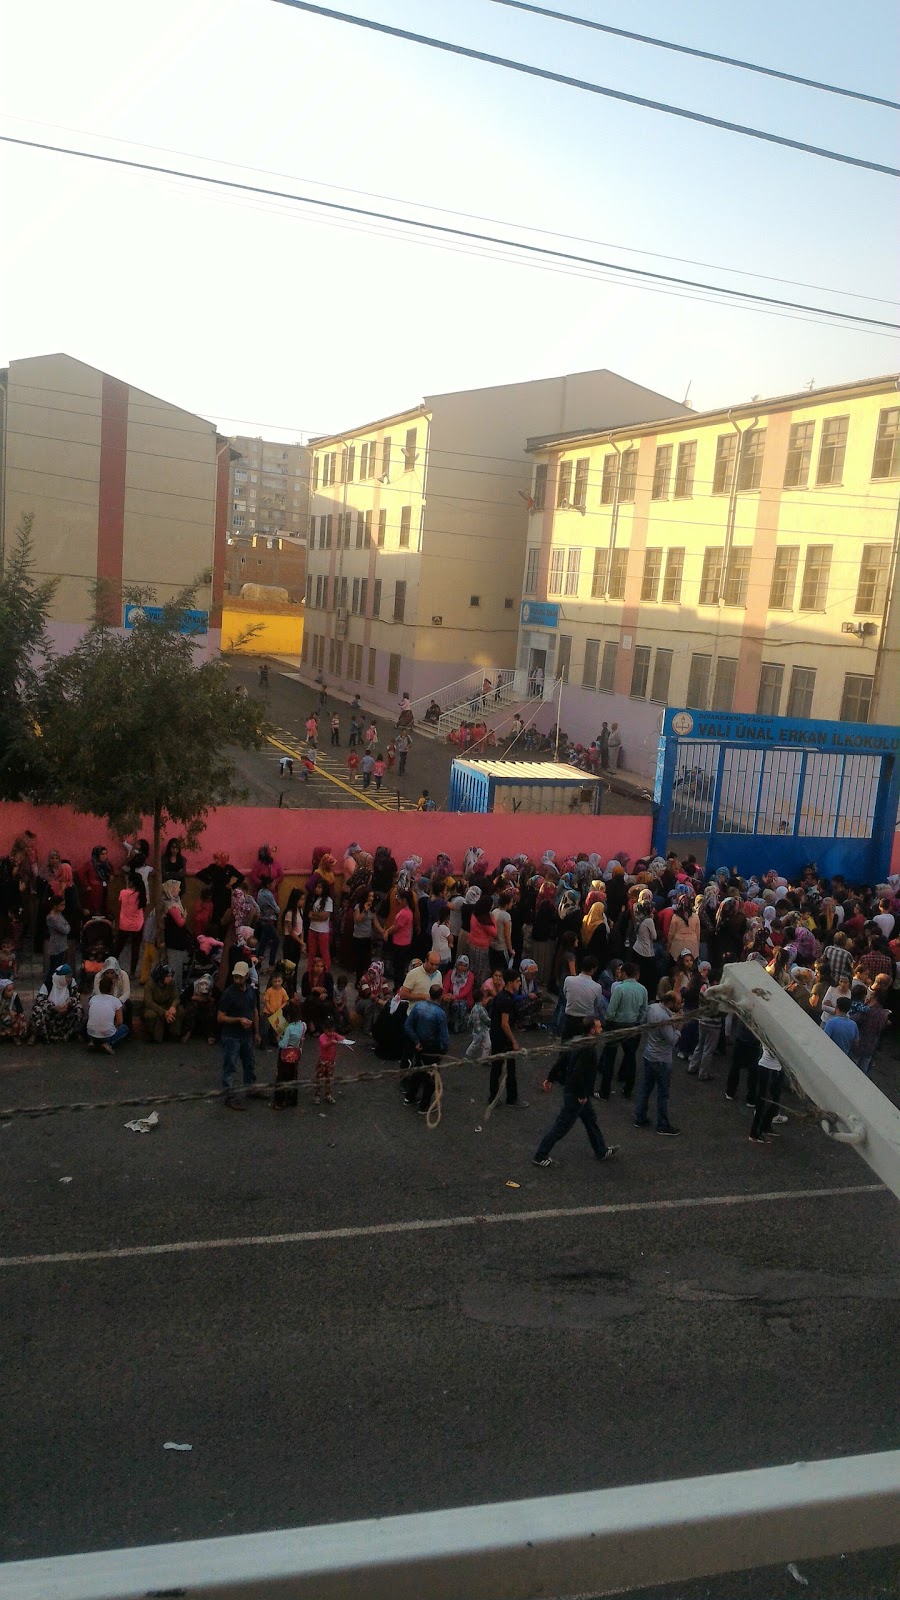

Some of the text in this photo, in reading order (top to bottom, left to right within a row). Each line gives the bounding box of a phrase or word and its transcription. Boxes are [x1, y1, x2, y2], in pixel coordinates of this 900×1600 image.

[698, 721, 900, 751] VALİ ÜNAL ERKAN İLKOKULU
